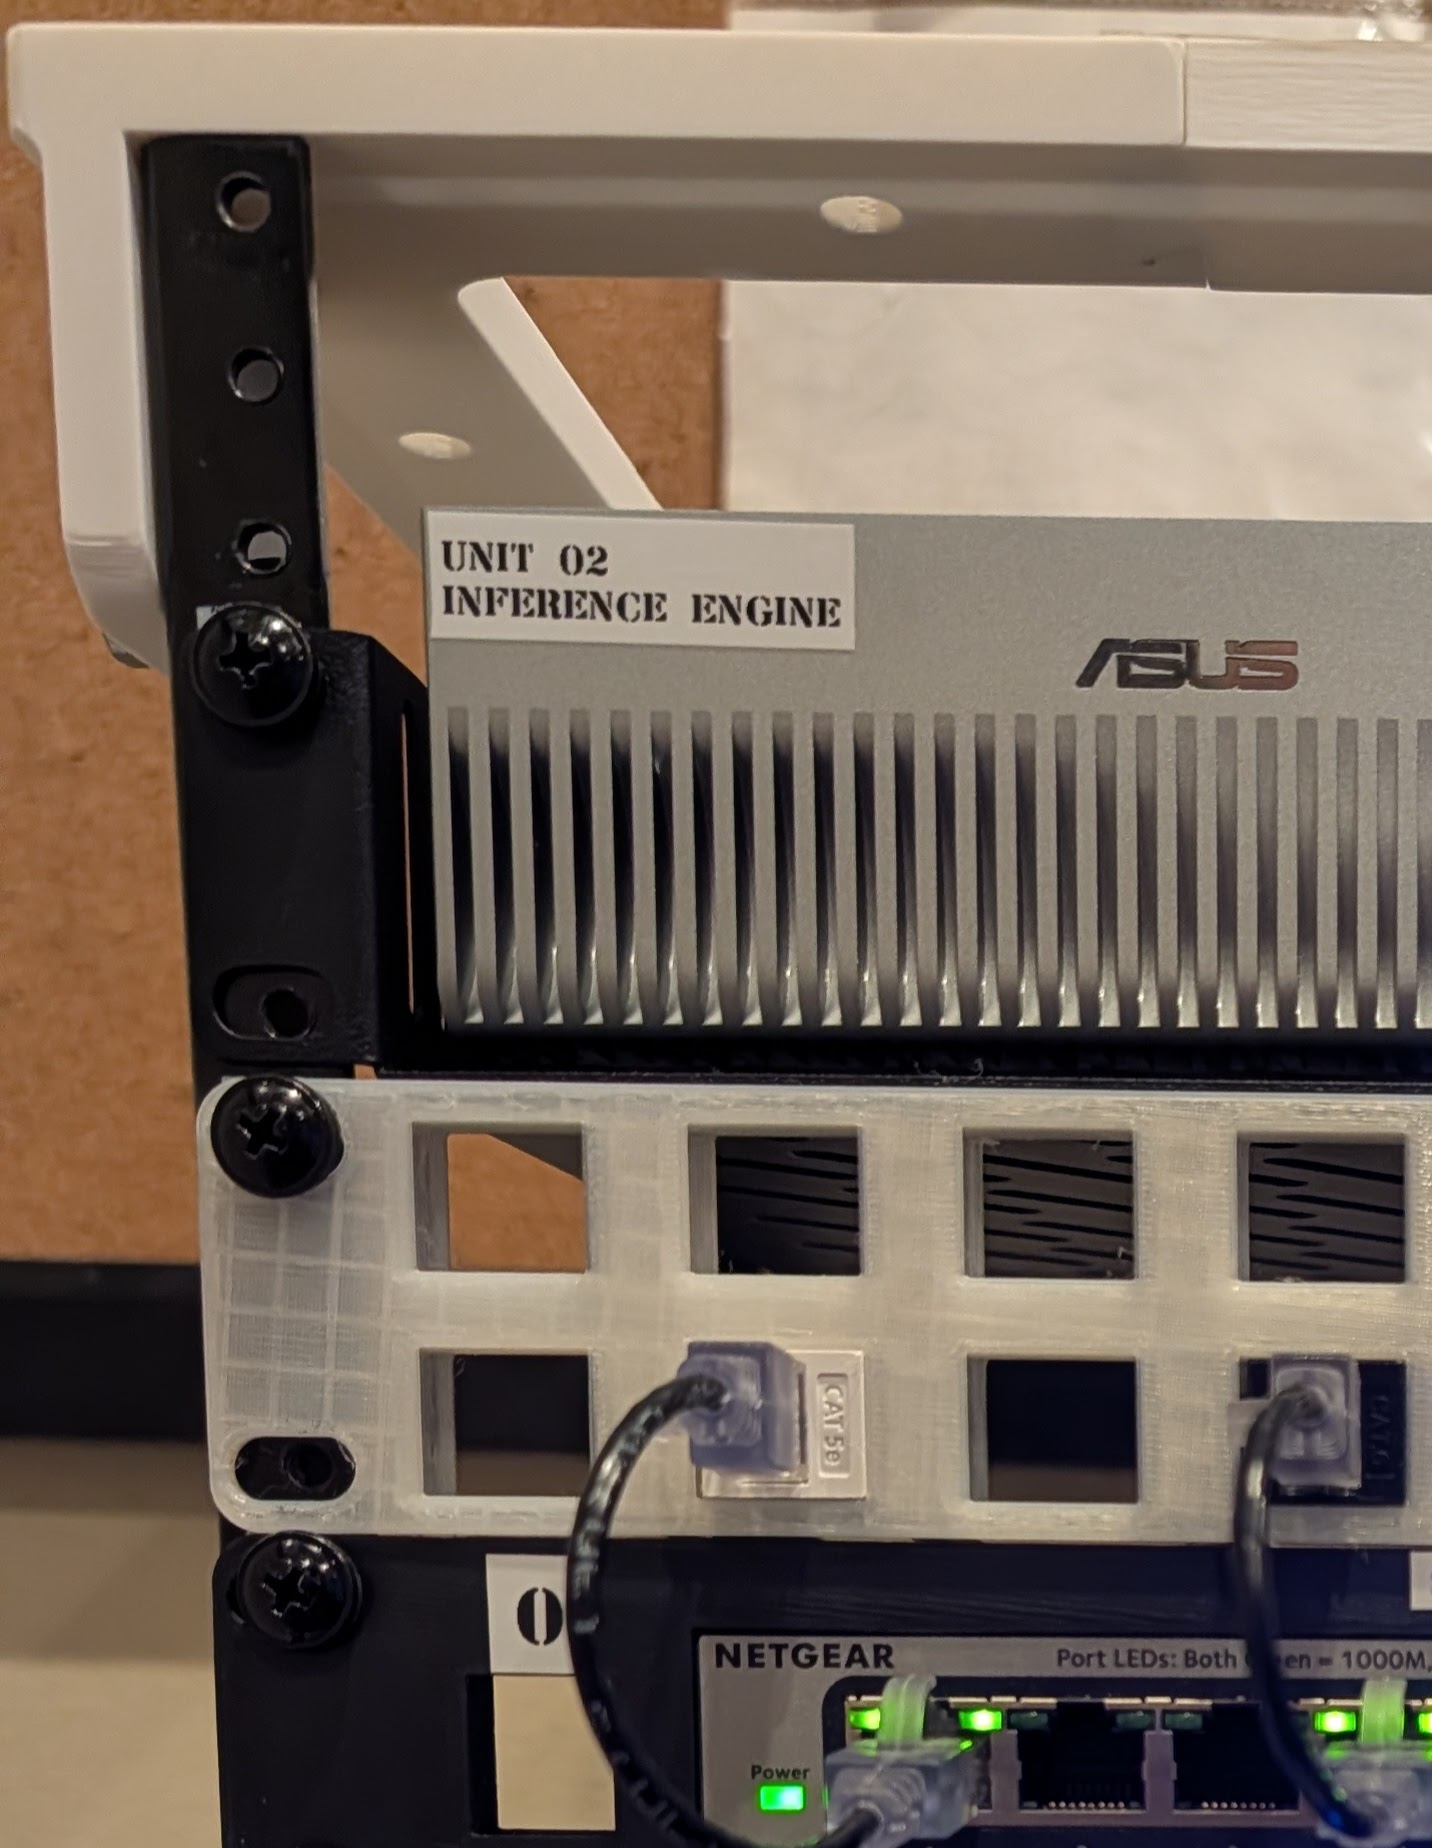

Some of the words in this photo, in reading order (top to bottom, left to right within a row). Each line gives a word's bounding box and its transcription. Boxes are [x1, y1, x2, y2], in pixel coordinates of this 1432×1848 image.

[441, 540, 535, 574] UNIT
[559, 544, 609, 577] 02
[441, 585, 668, 623] INFERENCE
[691, 593, 842, 628] ENGINE
[1074, 637, 1299, 691] ASUS
[822, 1383, 846, 1433] CAT
[714, 1642, 895, 1669] NETGEAR
[1056, 1648, 1107, 1669] Port
[1113, 1648, 1178, 1670] LEDs:
[1184, 1648, 1238, 1670] Both
[750, 1764, 811, 1781] Power
